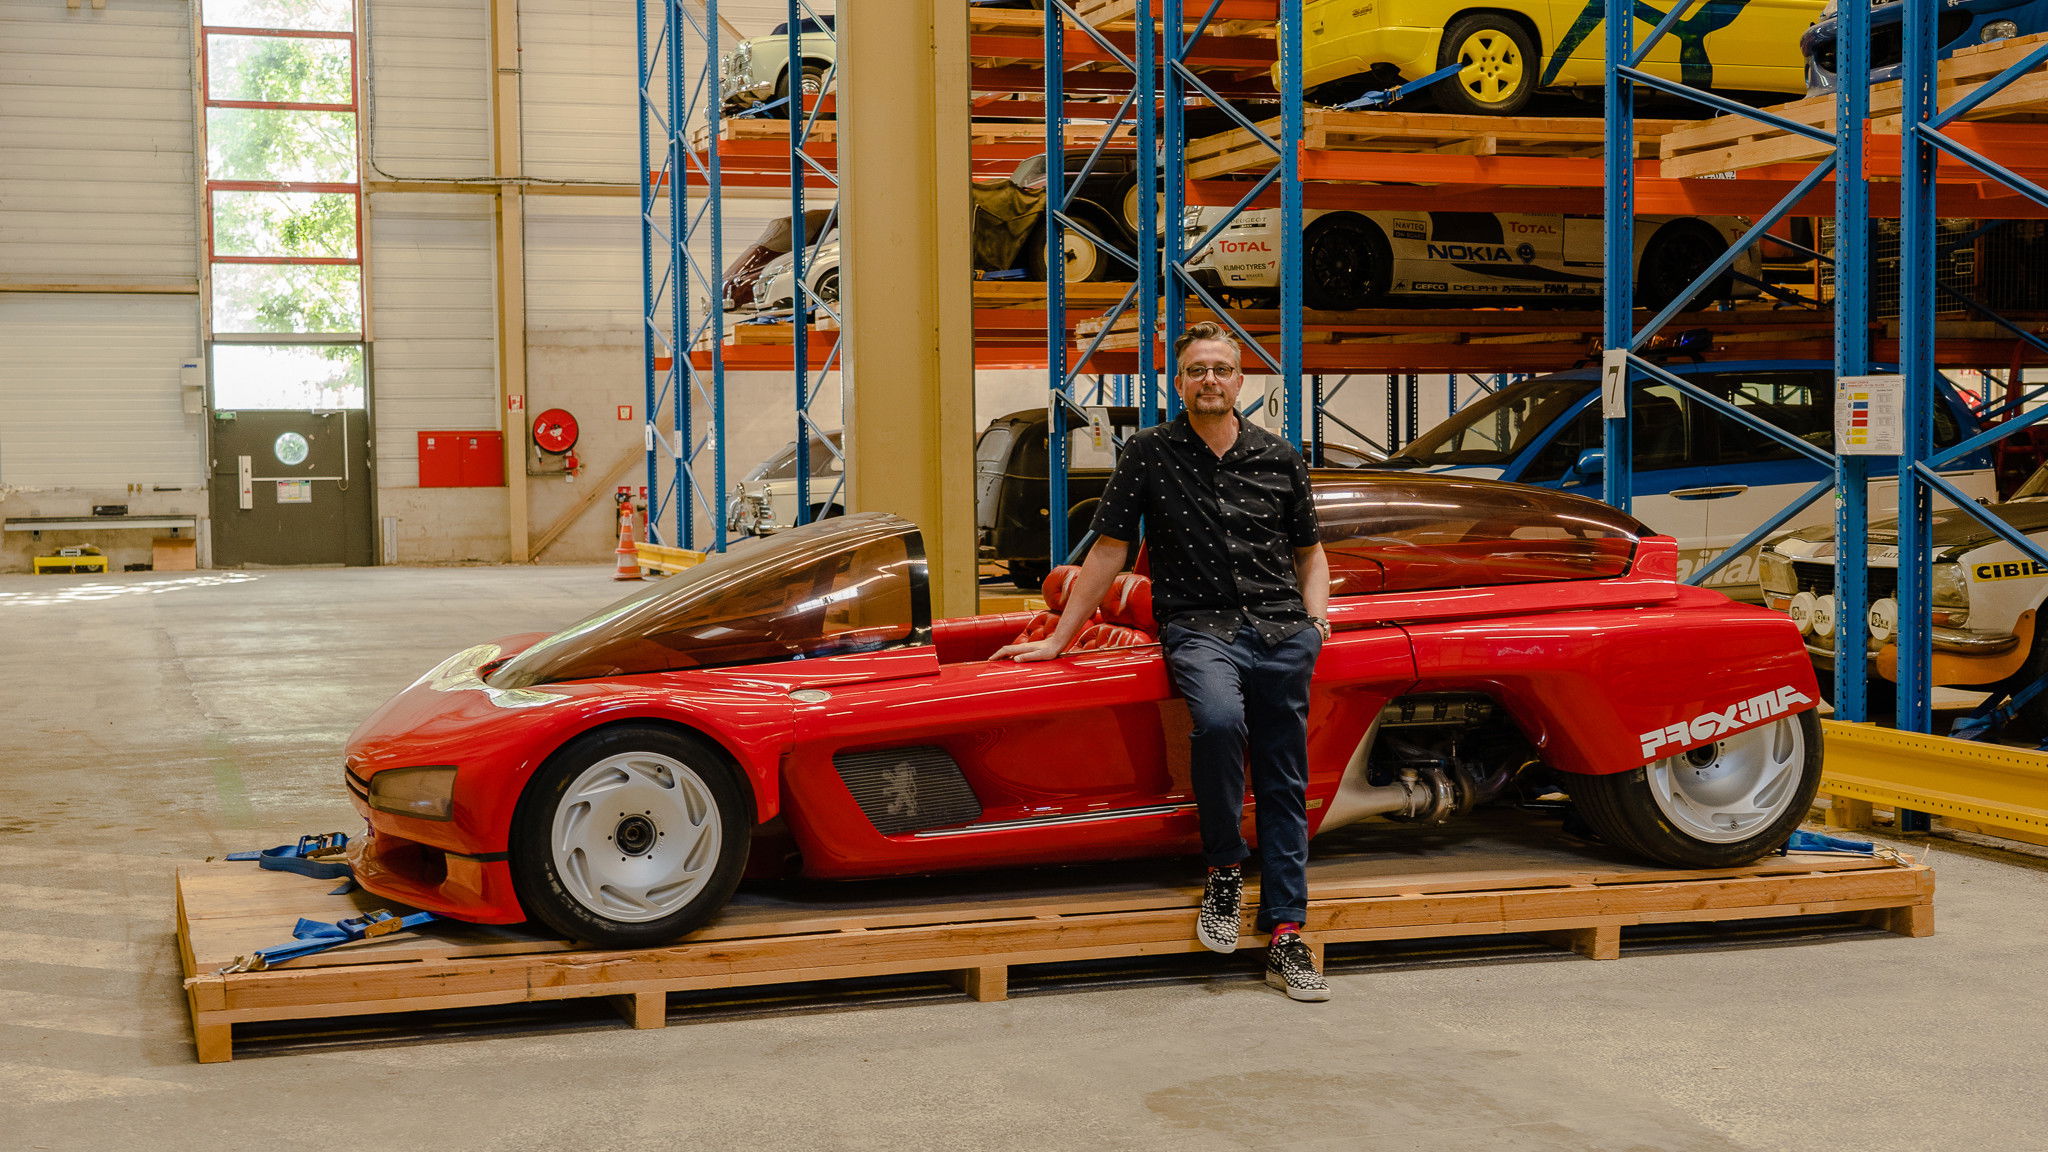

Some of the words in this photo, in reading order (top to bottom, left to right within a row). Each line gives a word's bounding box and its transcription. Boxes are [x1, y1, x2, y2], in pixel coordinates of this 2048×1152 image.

[1509, 221, 1557, 234] TOTAL
[1219, 241, 1272, 253] TOTAL
[1427, 244, 1512, 262] NOKIA
[1415, 283, 1446, 291] GEFCO
[1453, 284, 1497, 292] DELPHI
[1607, 365, 1620, 404] 7
[1268, 386, 1279, 417] 6
